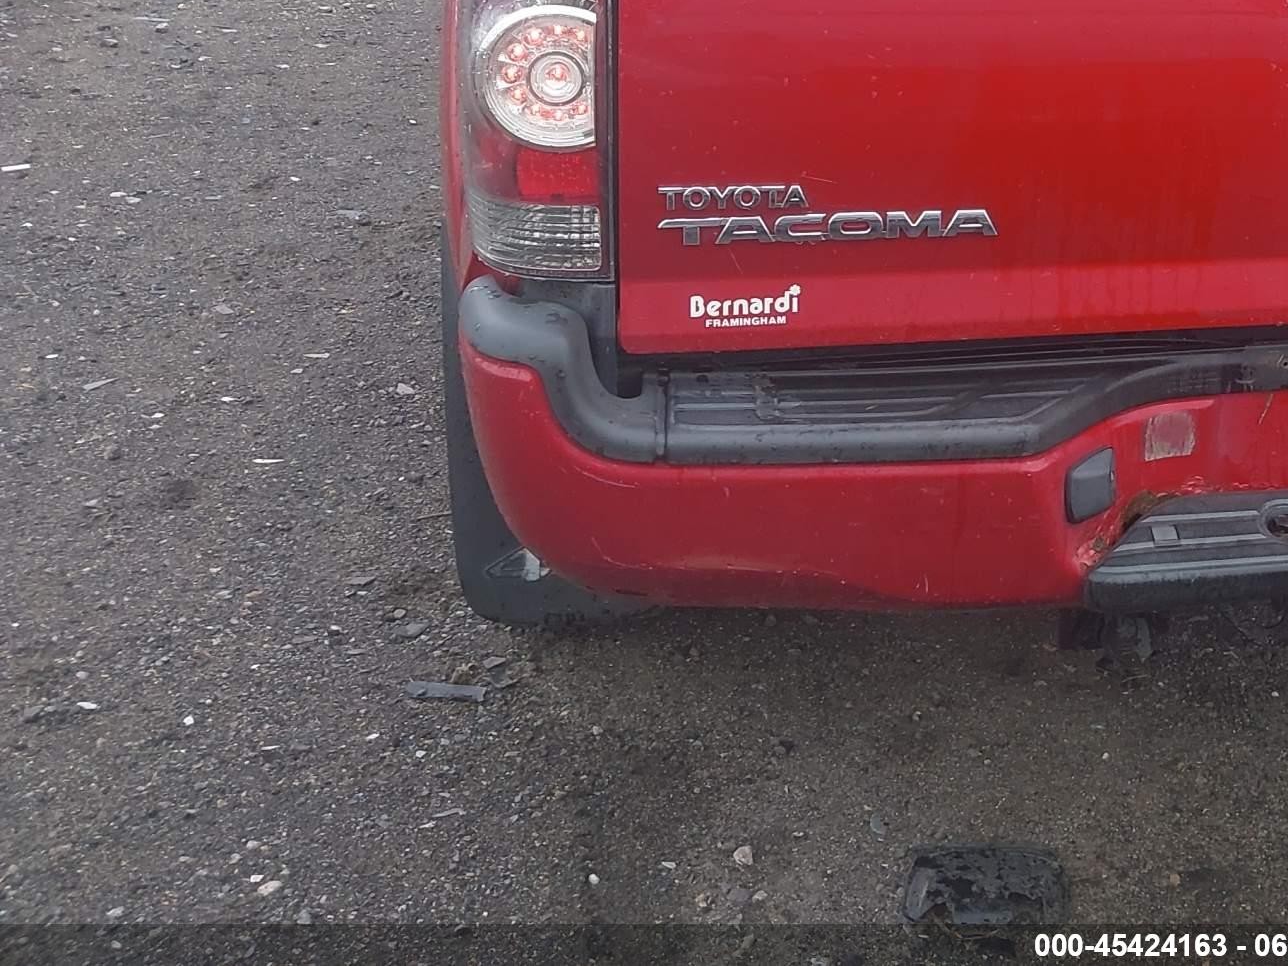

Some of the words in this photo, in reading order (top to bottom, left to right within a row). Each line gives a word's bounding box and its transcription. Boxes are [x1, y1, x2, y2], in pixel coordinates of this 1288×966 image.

[658, 185, 809, 210] TOYOTA
[658, 209, 999, 247] TACOMA
[689, 284, 800, 318] Bernardi
[705, 315, 787, 329] FRAMINGHAM
